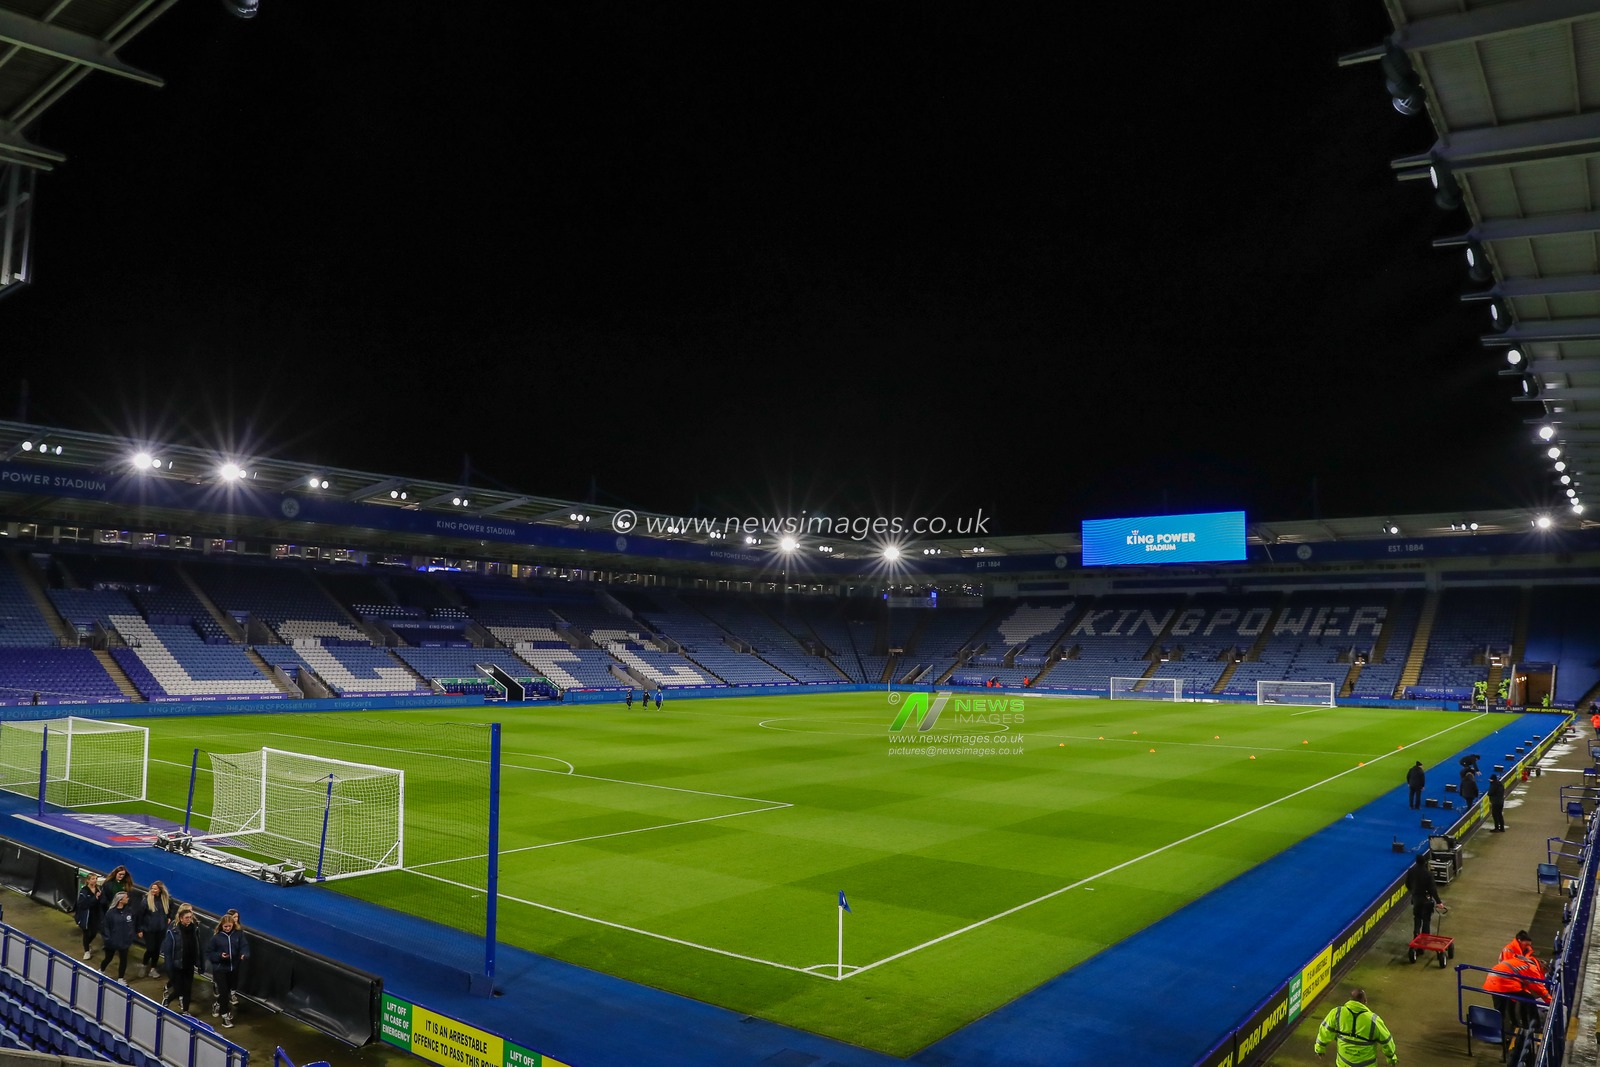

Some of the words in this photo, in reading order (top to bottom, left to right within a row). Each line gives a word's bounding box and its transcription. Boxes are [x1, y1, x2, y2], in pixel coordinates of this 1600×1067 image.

[2, 471, 50, 485] POWER
[54, 477, 106, 492] STADIUM
[436, 520, 457, 530] KING
[458, 522, 485, 533] POWER
[486, 526, 516, 536] STADIUM
[1126, 534, 1155, 545] KING
[1156, 532, 1196, 544] POWER
[1145, 544, 1176, 552] STADIUM
[1404, 543, 1424, 552] 1884
[386, 1001, 397, 1013] LIFT
[397, 1005, 407, 1016] OFF
[383, 1012, 390, 1022] IN
[390, 1015, 402, 1028] CASE
[402, 1019, 410, 1030] OF
[382, 1024, 411, 1043] EMERGENCY
[425, 1019, 431, 1031] IT
[432, 1022, 439, 1034] IS
[440, 1025, 448, 1038] AN
[449, 1029, 488, 1054] ARRESTABLE
[413, 1032, 439, 1053] OFFENCE
[440, 1042, 448, 1056] TO
[449, 1046, 464, 1063] PASS
[465, 1053, 480, 1067] THIS
[509, 1050, 523, 1062] LIFT
[523, 1055, 535, 1067] OFF
